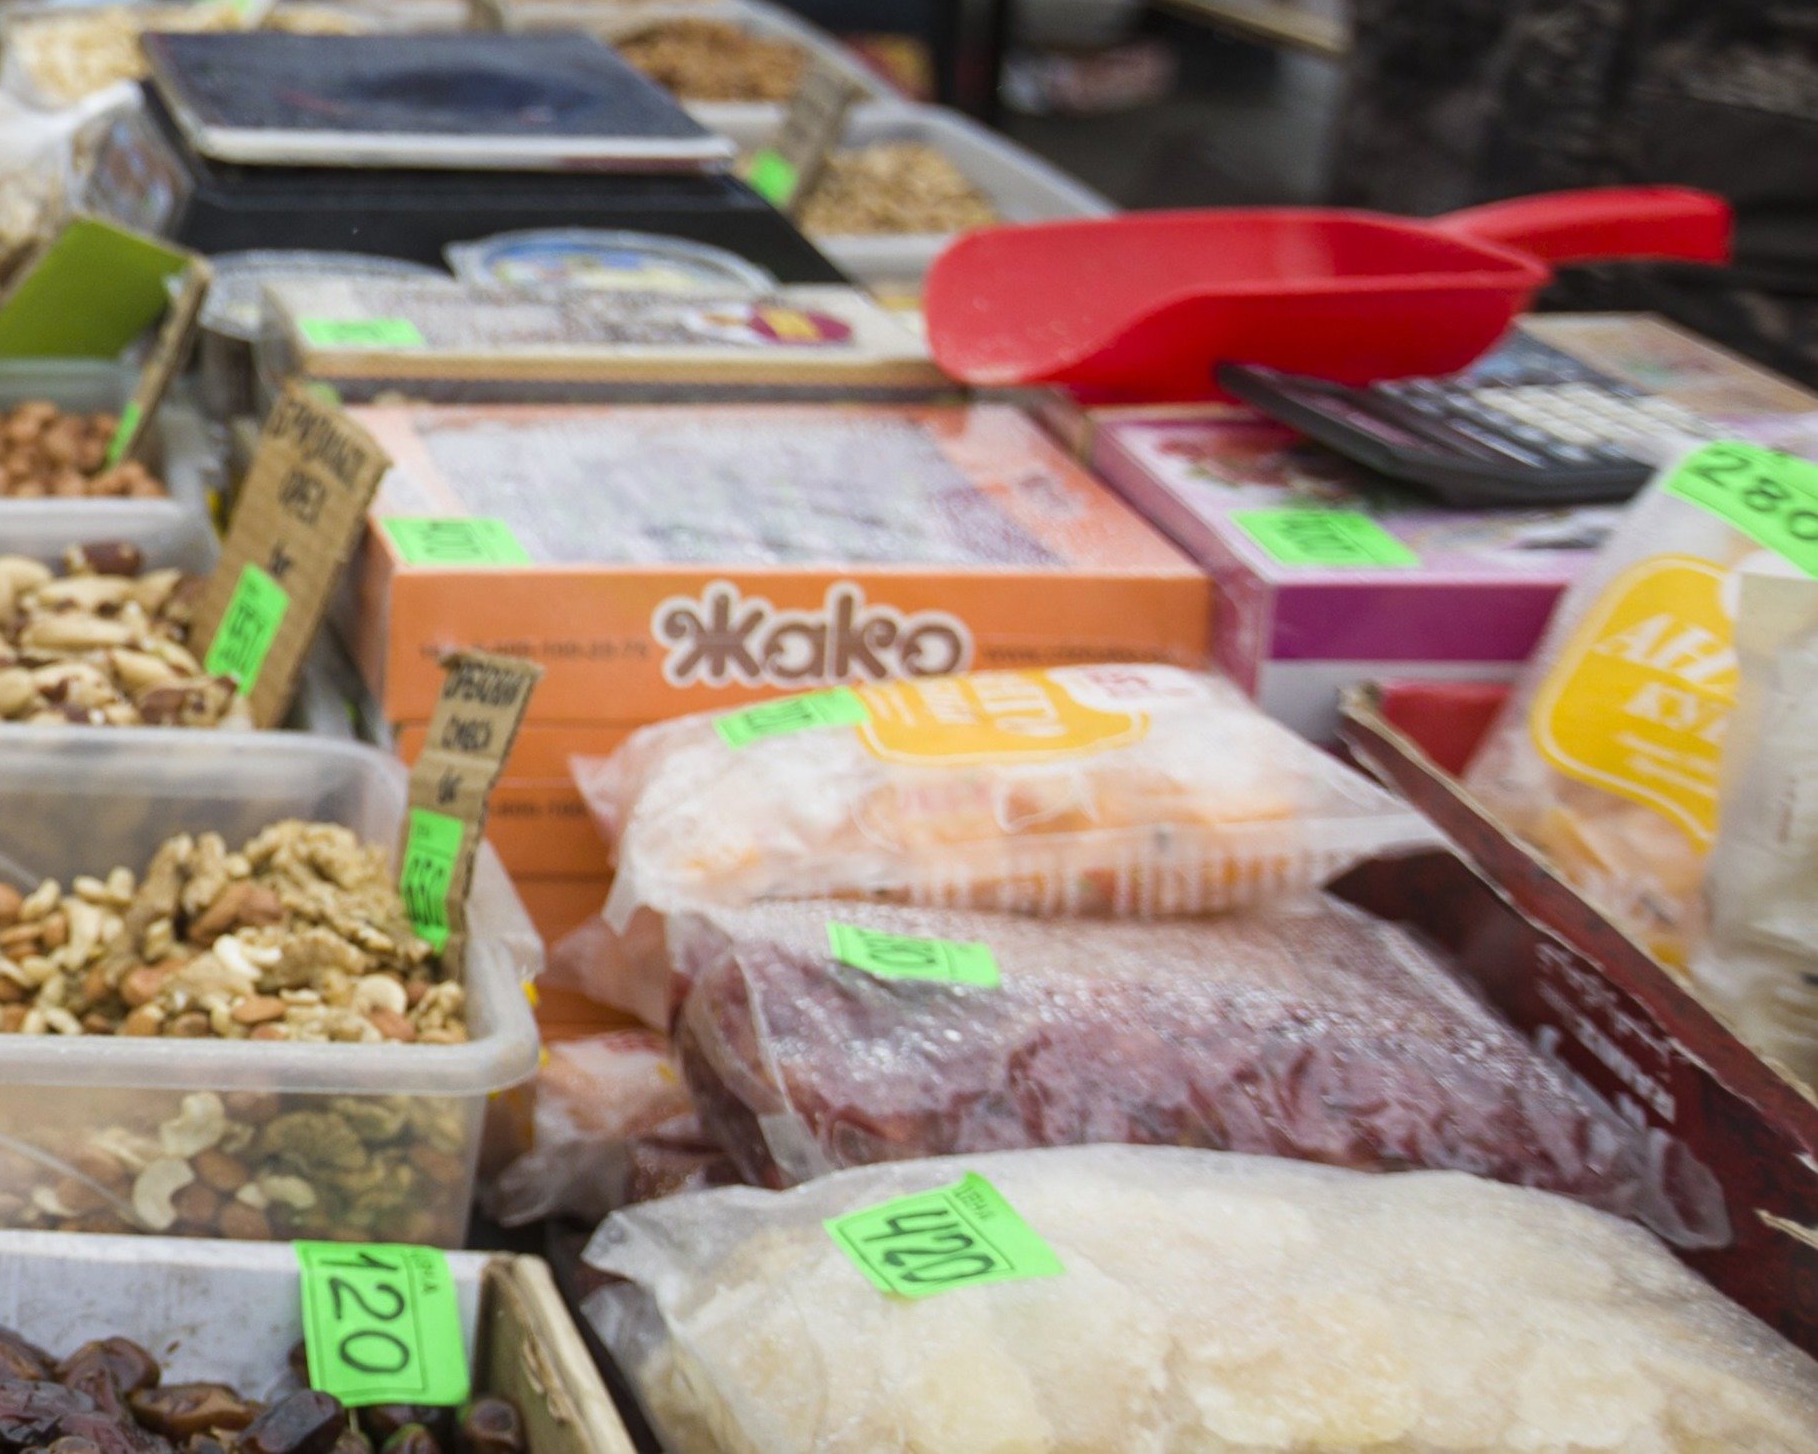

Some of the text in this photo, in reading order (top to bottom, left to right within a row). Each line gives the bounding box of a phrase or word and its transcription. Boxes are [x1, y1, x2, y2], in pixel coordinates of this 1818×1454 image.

[658, 588, 968, 682] Жако
[863, 1207, 997, 1284] 420
[319, 1251, 411, 1375] 120
